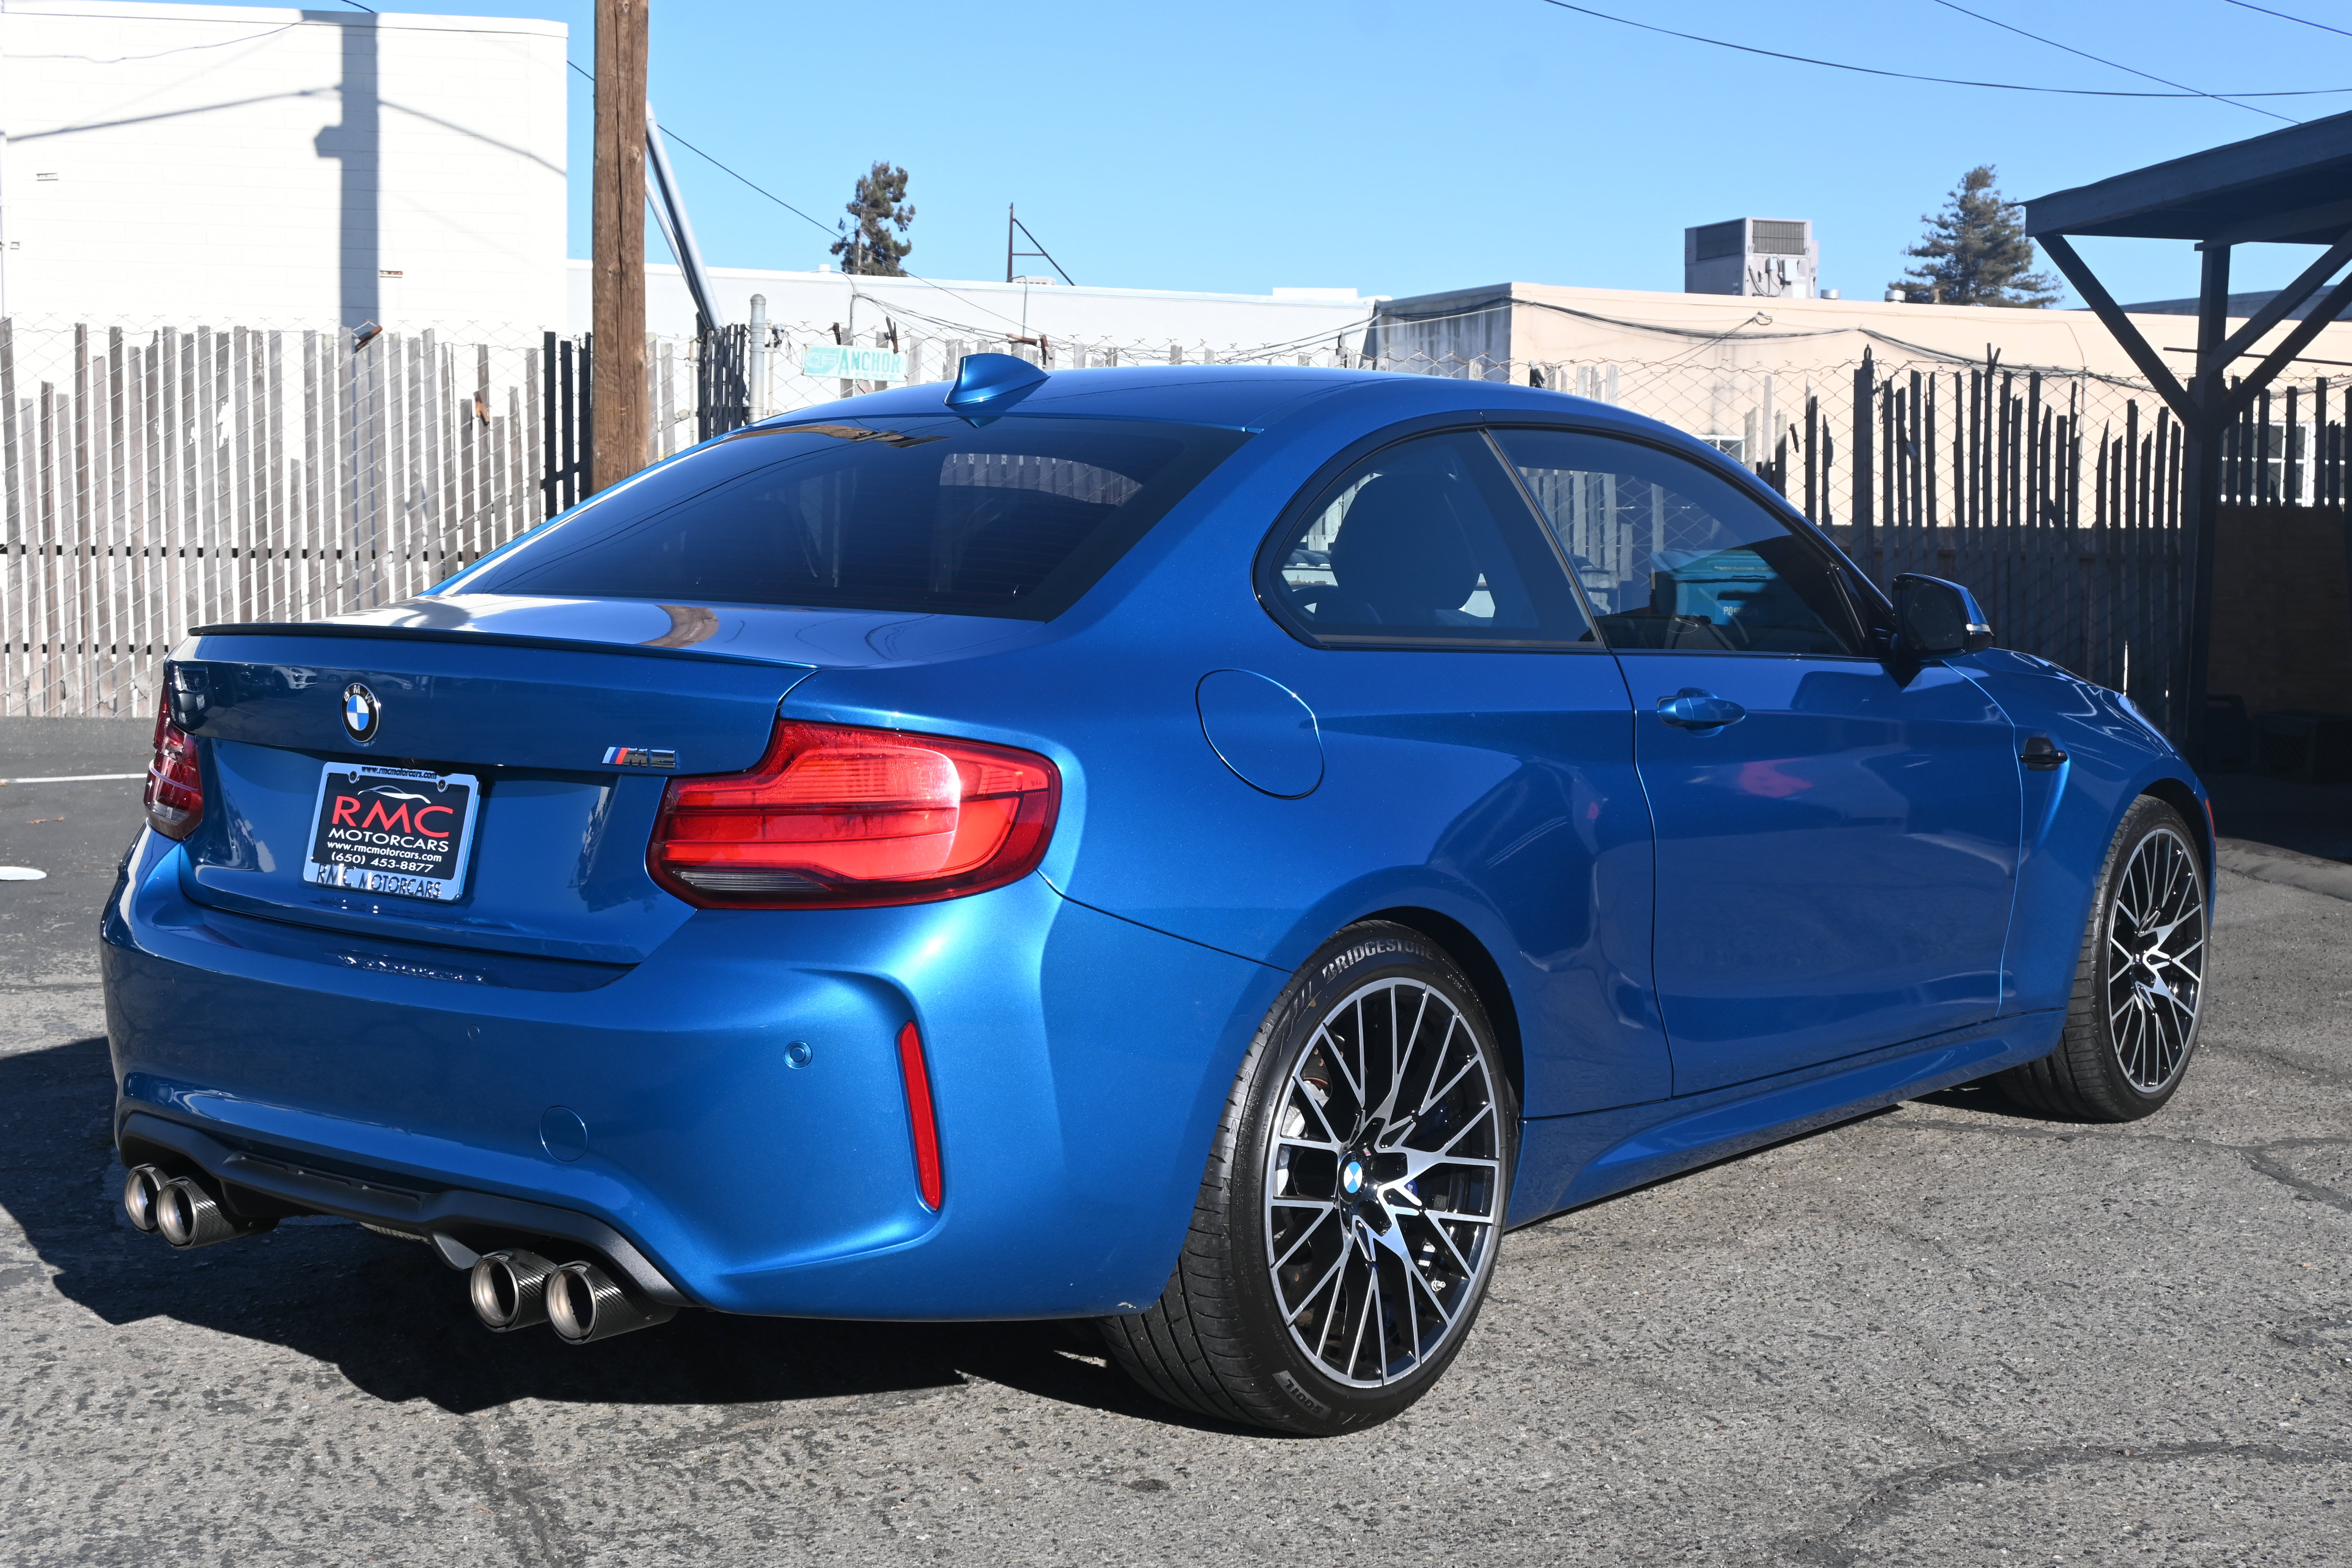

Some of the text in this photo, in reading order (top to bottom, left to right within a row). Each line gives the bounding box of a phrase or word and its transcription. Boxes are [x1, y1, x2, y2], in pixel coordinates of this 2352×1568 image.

[837, 348, 901, 376] ANCHOR
[344, 685, 373, 704] BMW
[622, 747, 676, 768] M2
[361, 766, 437, 780] www.rmcmotorcars.com
[332, 795, 453, 838] RMC
[328, 828, 449, 852] MOTORCARS
[327, 841, 442, 863] www.rmcmotorcars.com
[331, 851, 434, 873] (650) 453-8877
[317, 863, 442, 899] RMC MOTORCARS
[1322, 938, 1434, 985] BRIDGESTONE
